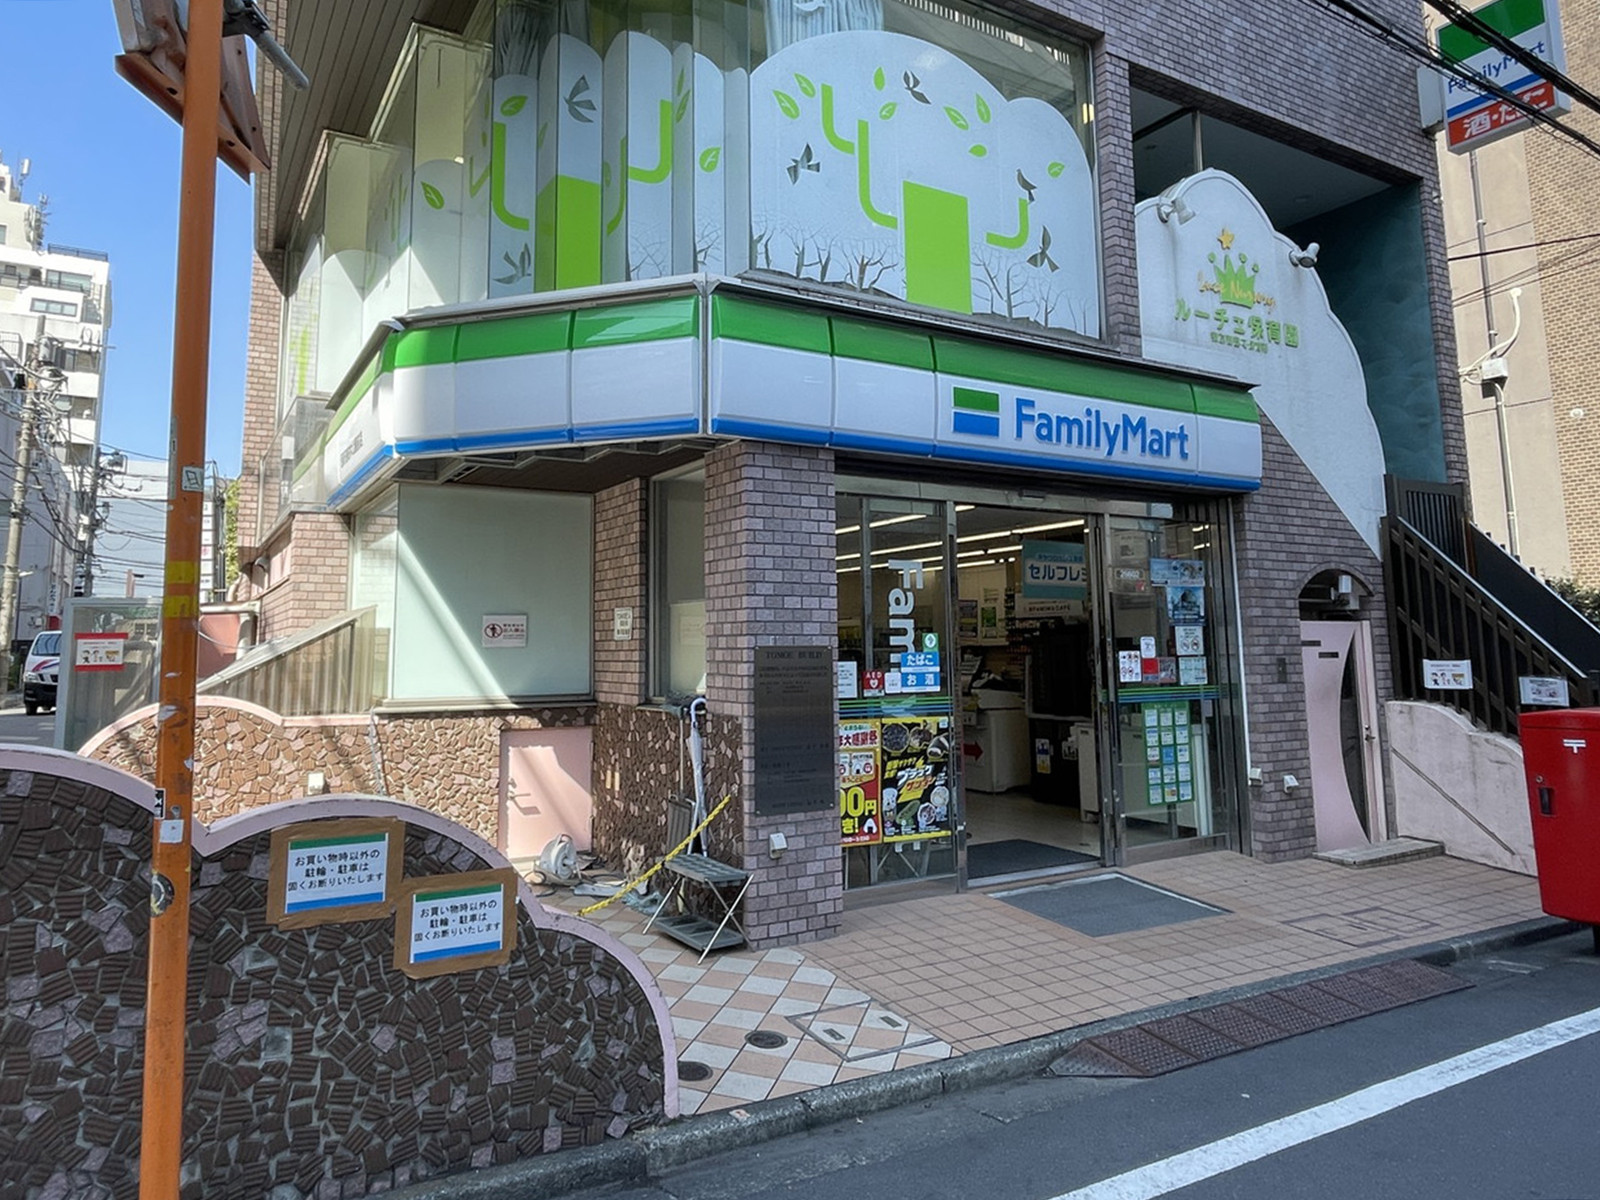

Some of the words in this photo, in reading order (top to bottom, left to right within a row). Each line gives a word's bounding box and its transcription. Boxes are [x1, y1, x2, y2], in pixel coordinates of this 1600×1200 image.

[1015, 397, 1189, 460] FamilyMart
[907, 654, 934, 665] たばこ
[865, 671, 882, 679] AED
[294, 848, 381, 867] お買い物時以外の
[288, 872, 384, 892] 固くお断りいたします
[420, 899, 498, 917] お買い物時以外の
[414, 922, 501, 942] 固くお断りいたします
